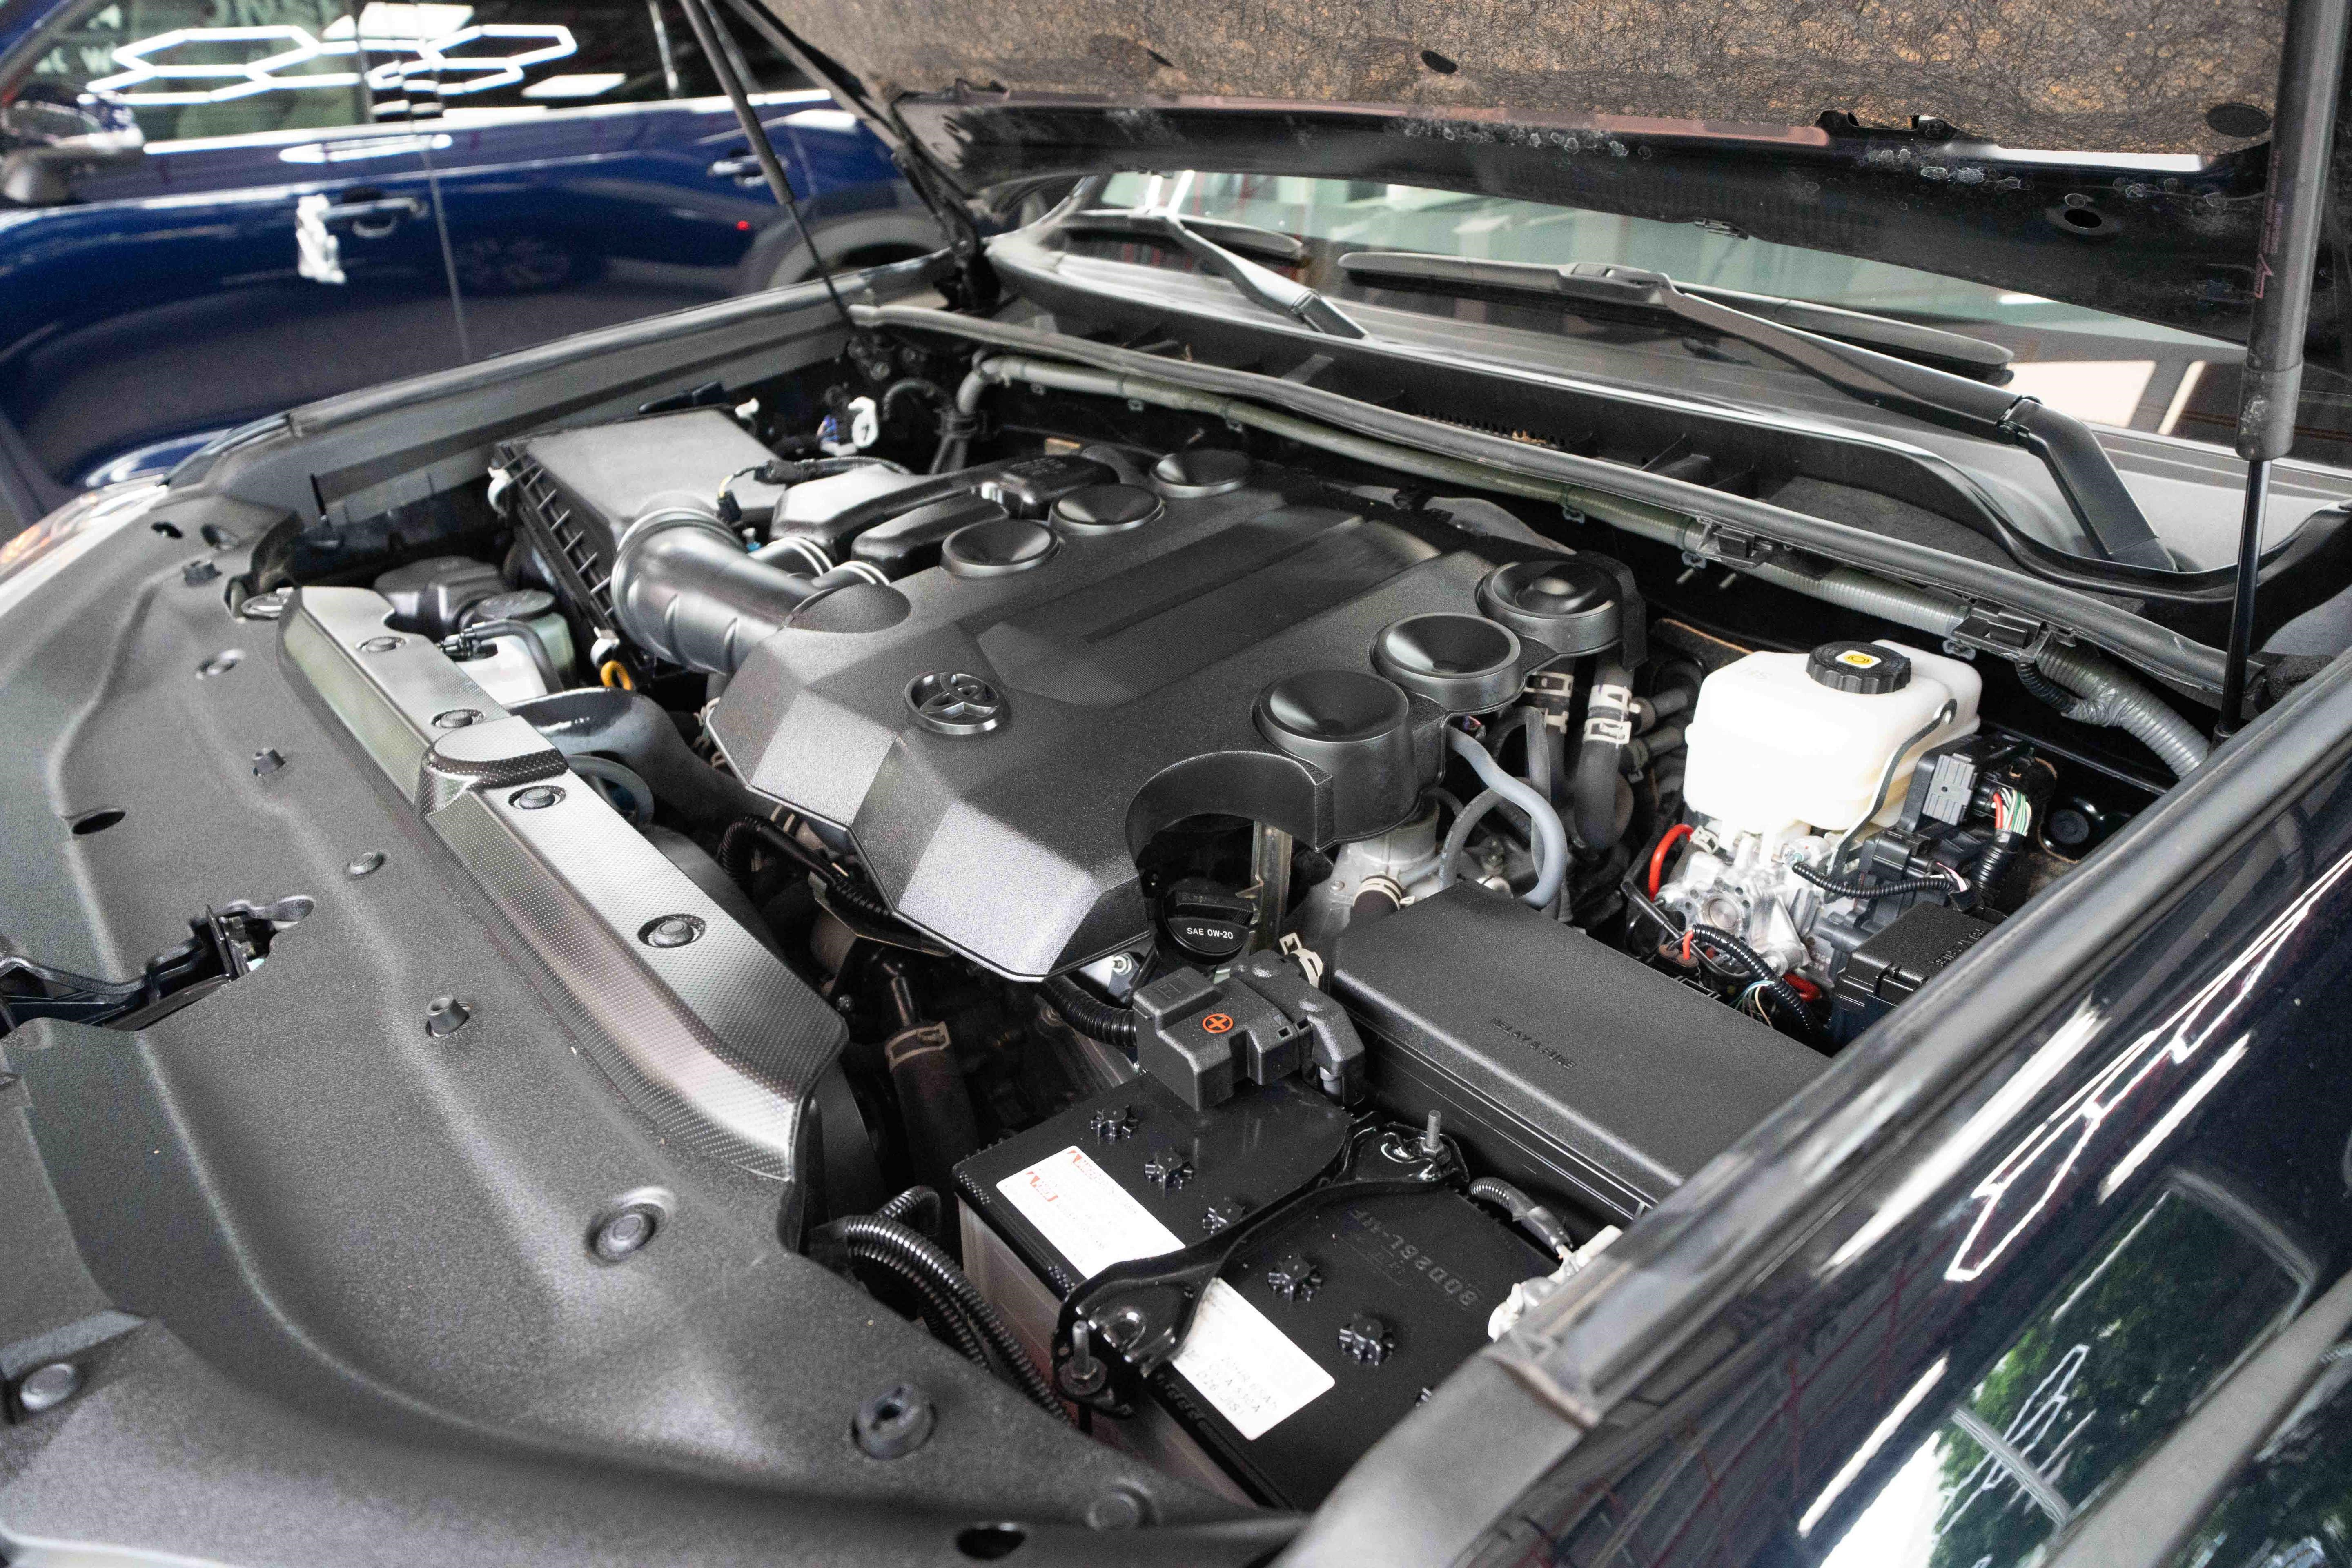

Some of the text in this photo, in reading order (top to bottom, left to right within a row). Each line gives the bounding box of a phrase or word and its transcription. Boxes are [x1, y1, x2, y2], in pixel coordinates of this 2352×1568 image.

[1207, 929, 1233, 939] 0W-20
[1490, 1017, 1530, 1042] RELAY
[1541, 1046, 1577, 1070] FUSE
